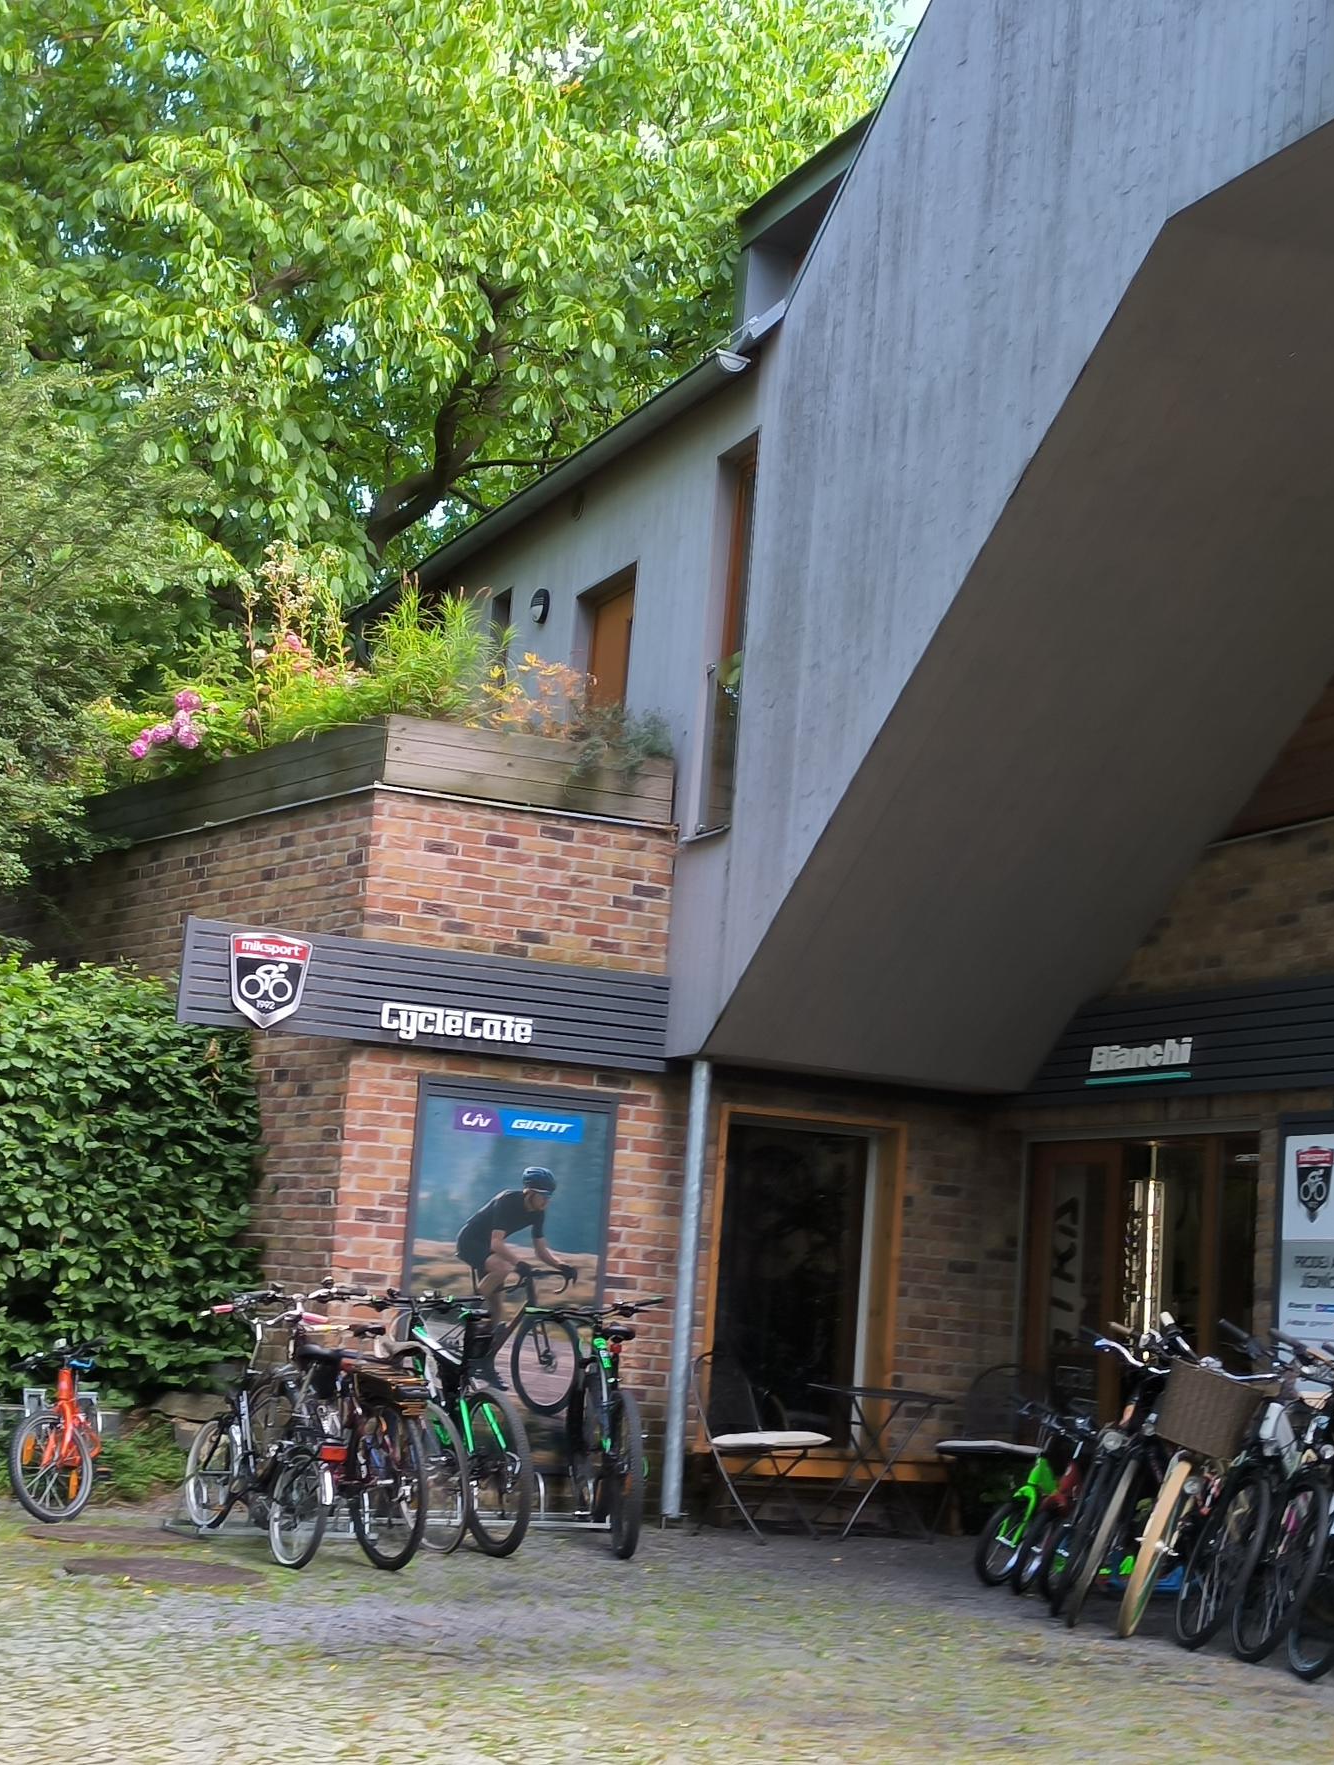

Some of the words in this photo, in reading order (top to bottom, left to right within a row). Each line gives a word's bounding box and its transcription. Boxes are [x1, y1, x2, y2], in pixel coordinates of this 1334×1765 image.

[241, 940, 303, 956] miksport
[1089, 1036, 1193, 1072] Bianchi
[511, 1119, 575, 1133] GIANT
